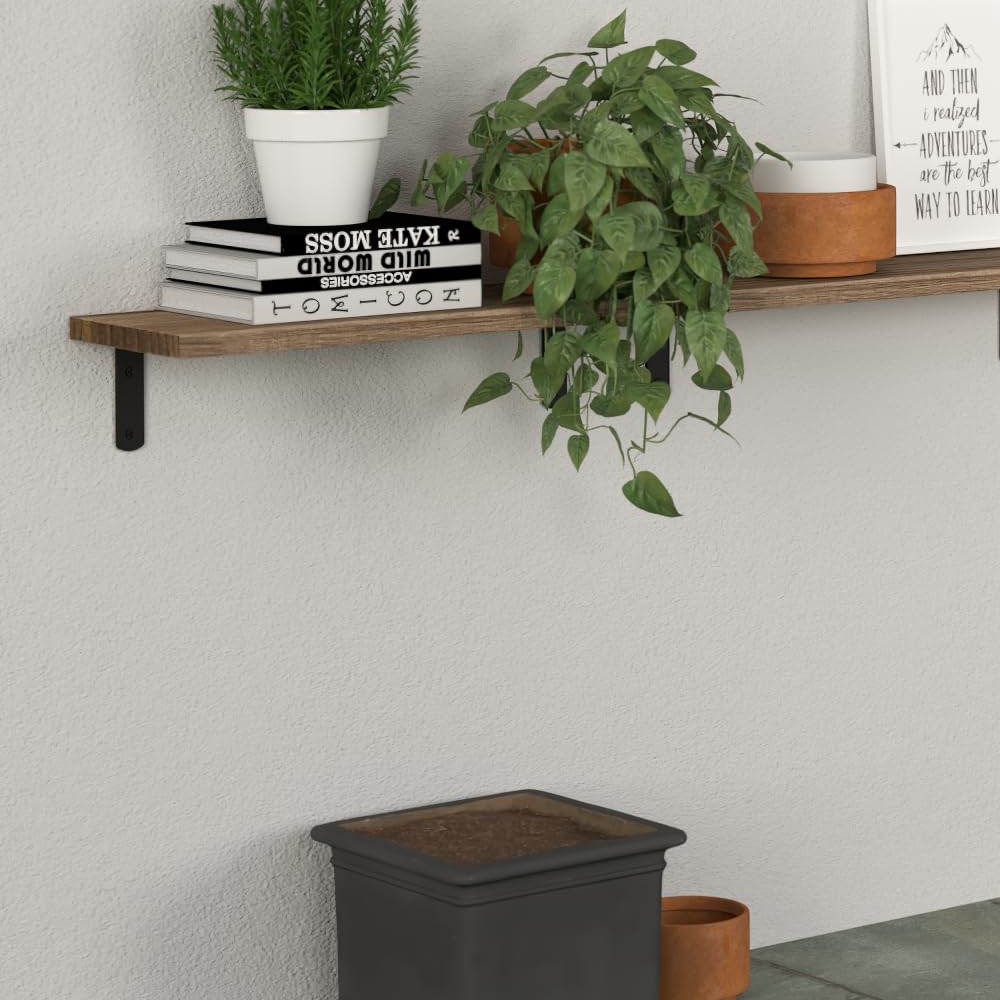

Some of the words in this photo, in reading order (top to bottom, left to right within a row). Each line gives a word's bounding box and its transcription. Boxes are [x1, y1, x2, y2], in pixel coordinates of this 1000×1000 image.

[922, 69, 945, 96] AND
[949, 67, 978, 95] THEN
[933, 97, 979, 128] realized
[919, 129, 989, 159] ADVENTURES
[920, 166, 940, 182] are
[938, 160, 963, 186] the
[967, 159, 1000, 188] best
[914, 191, 941, 220] WAY
[946, 191, 961, 218] TO
[966, 188, 999, 216] LEARN
[304, 229, 373, 254] MOSS
[377, 225, 441, 249] KATE
[297, 252, 373, 275] WORLD
[380, 249, 431, 269] WILD
[320, 270, 413, 289] ACCESSORIES
